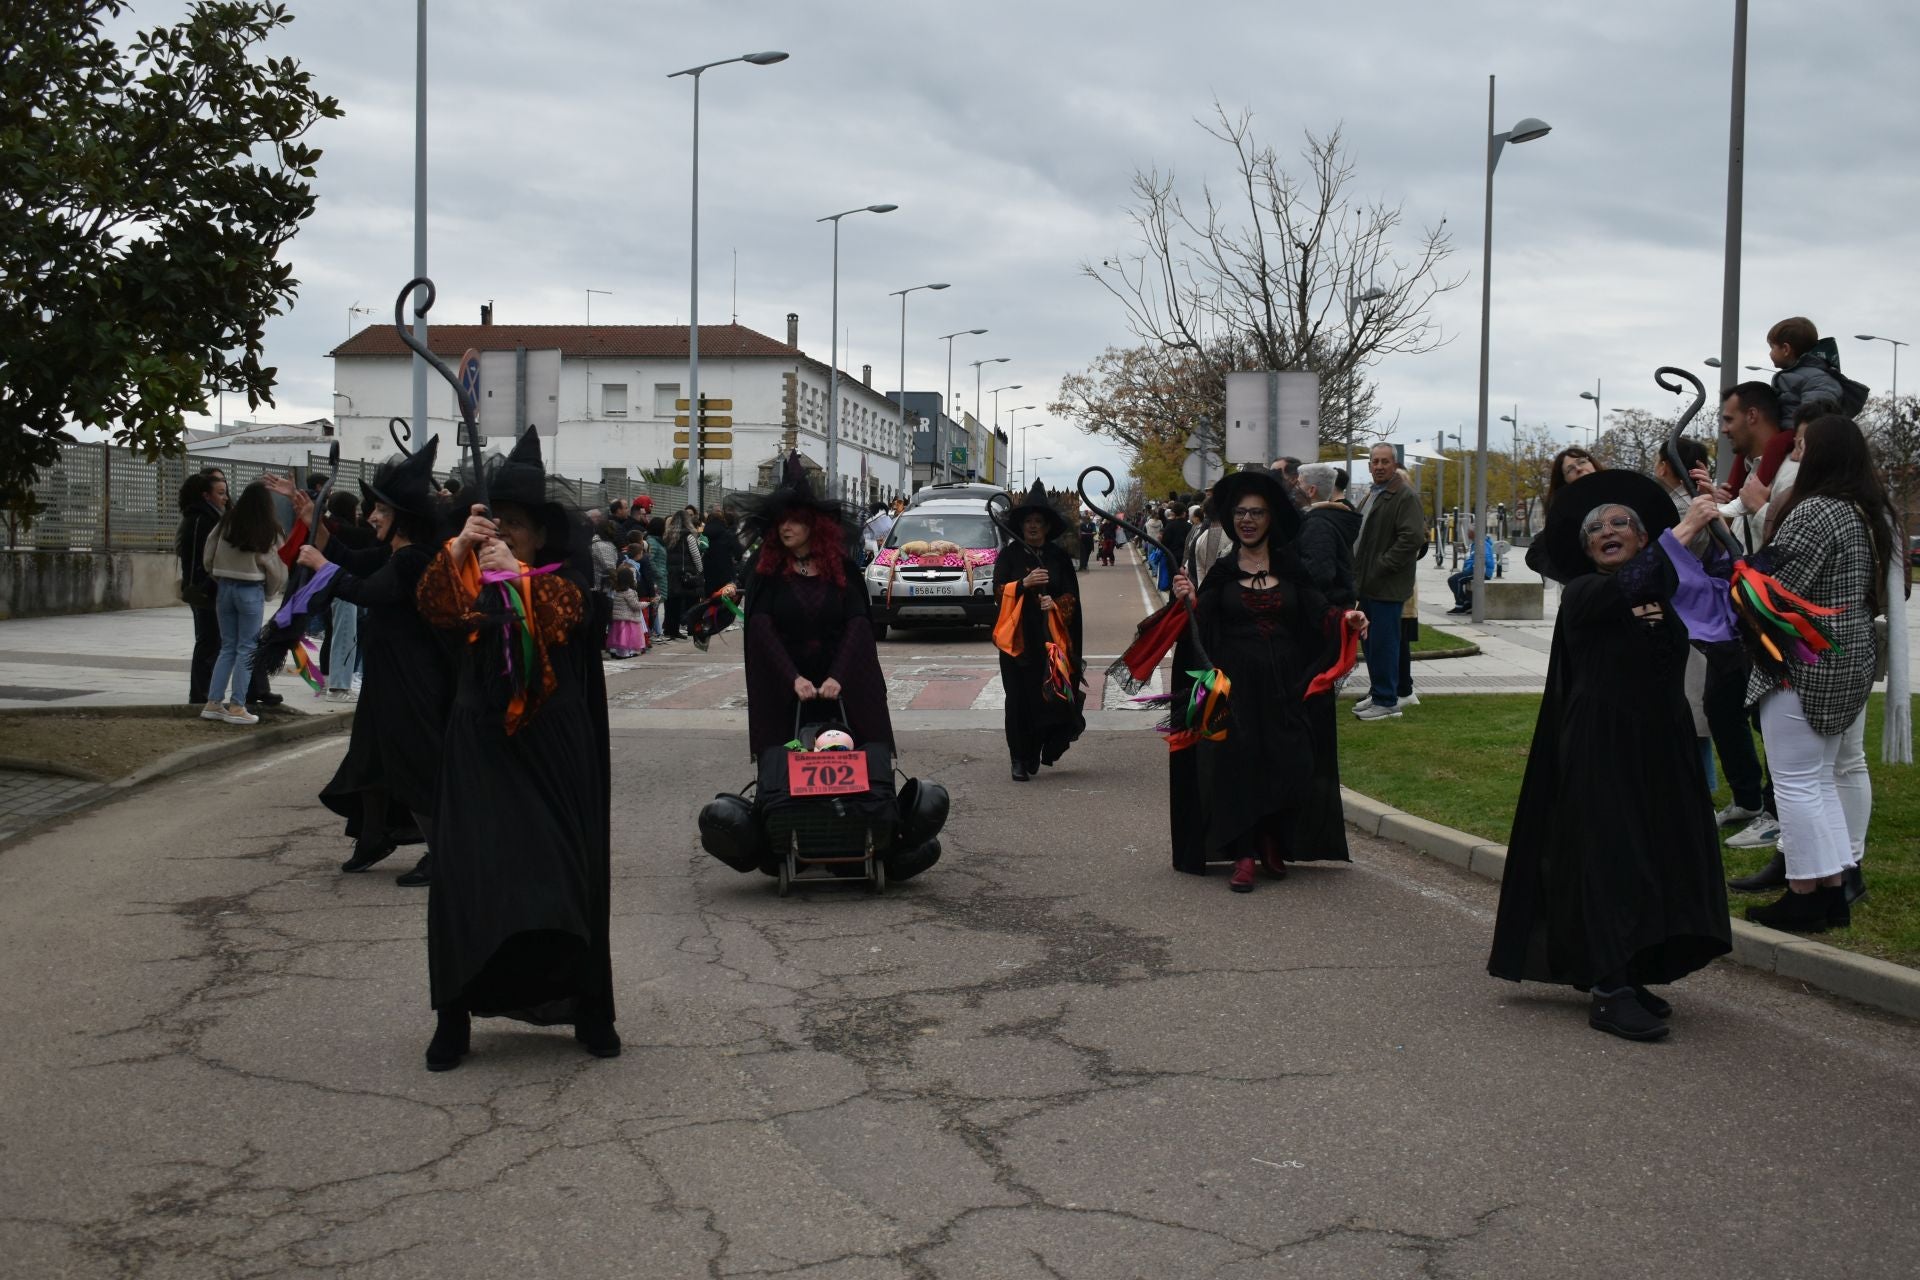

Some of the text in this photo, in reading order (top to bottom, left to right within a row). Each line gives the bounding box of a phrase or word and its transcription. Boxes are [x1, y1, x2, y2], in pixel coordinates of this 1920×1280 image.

[915, 586, 952, 595] 8584 FGS
[802, 765, 855, 786] 702
